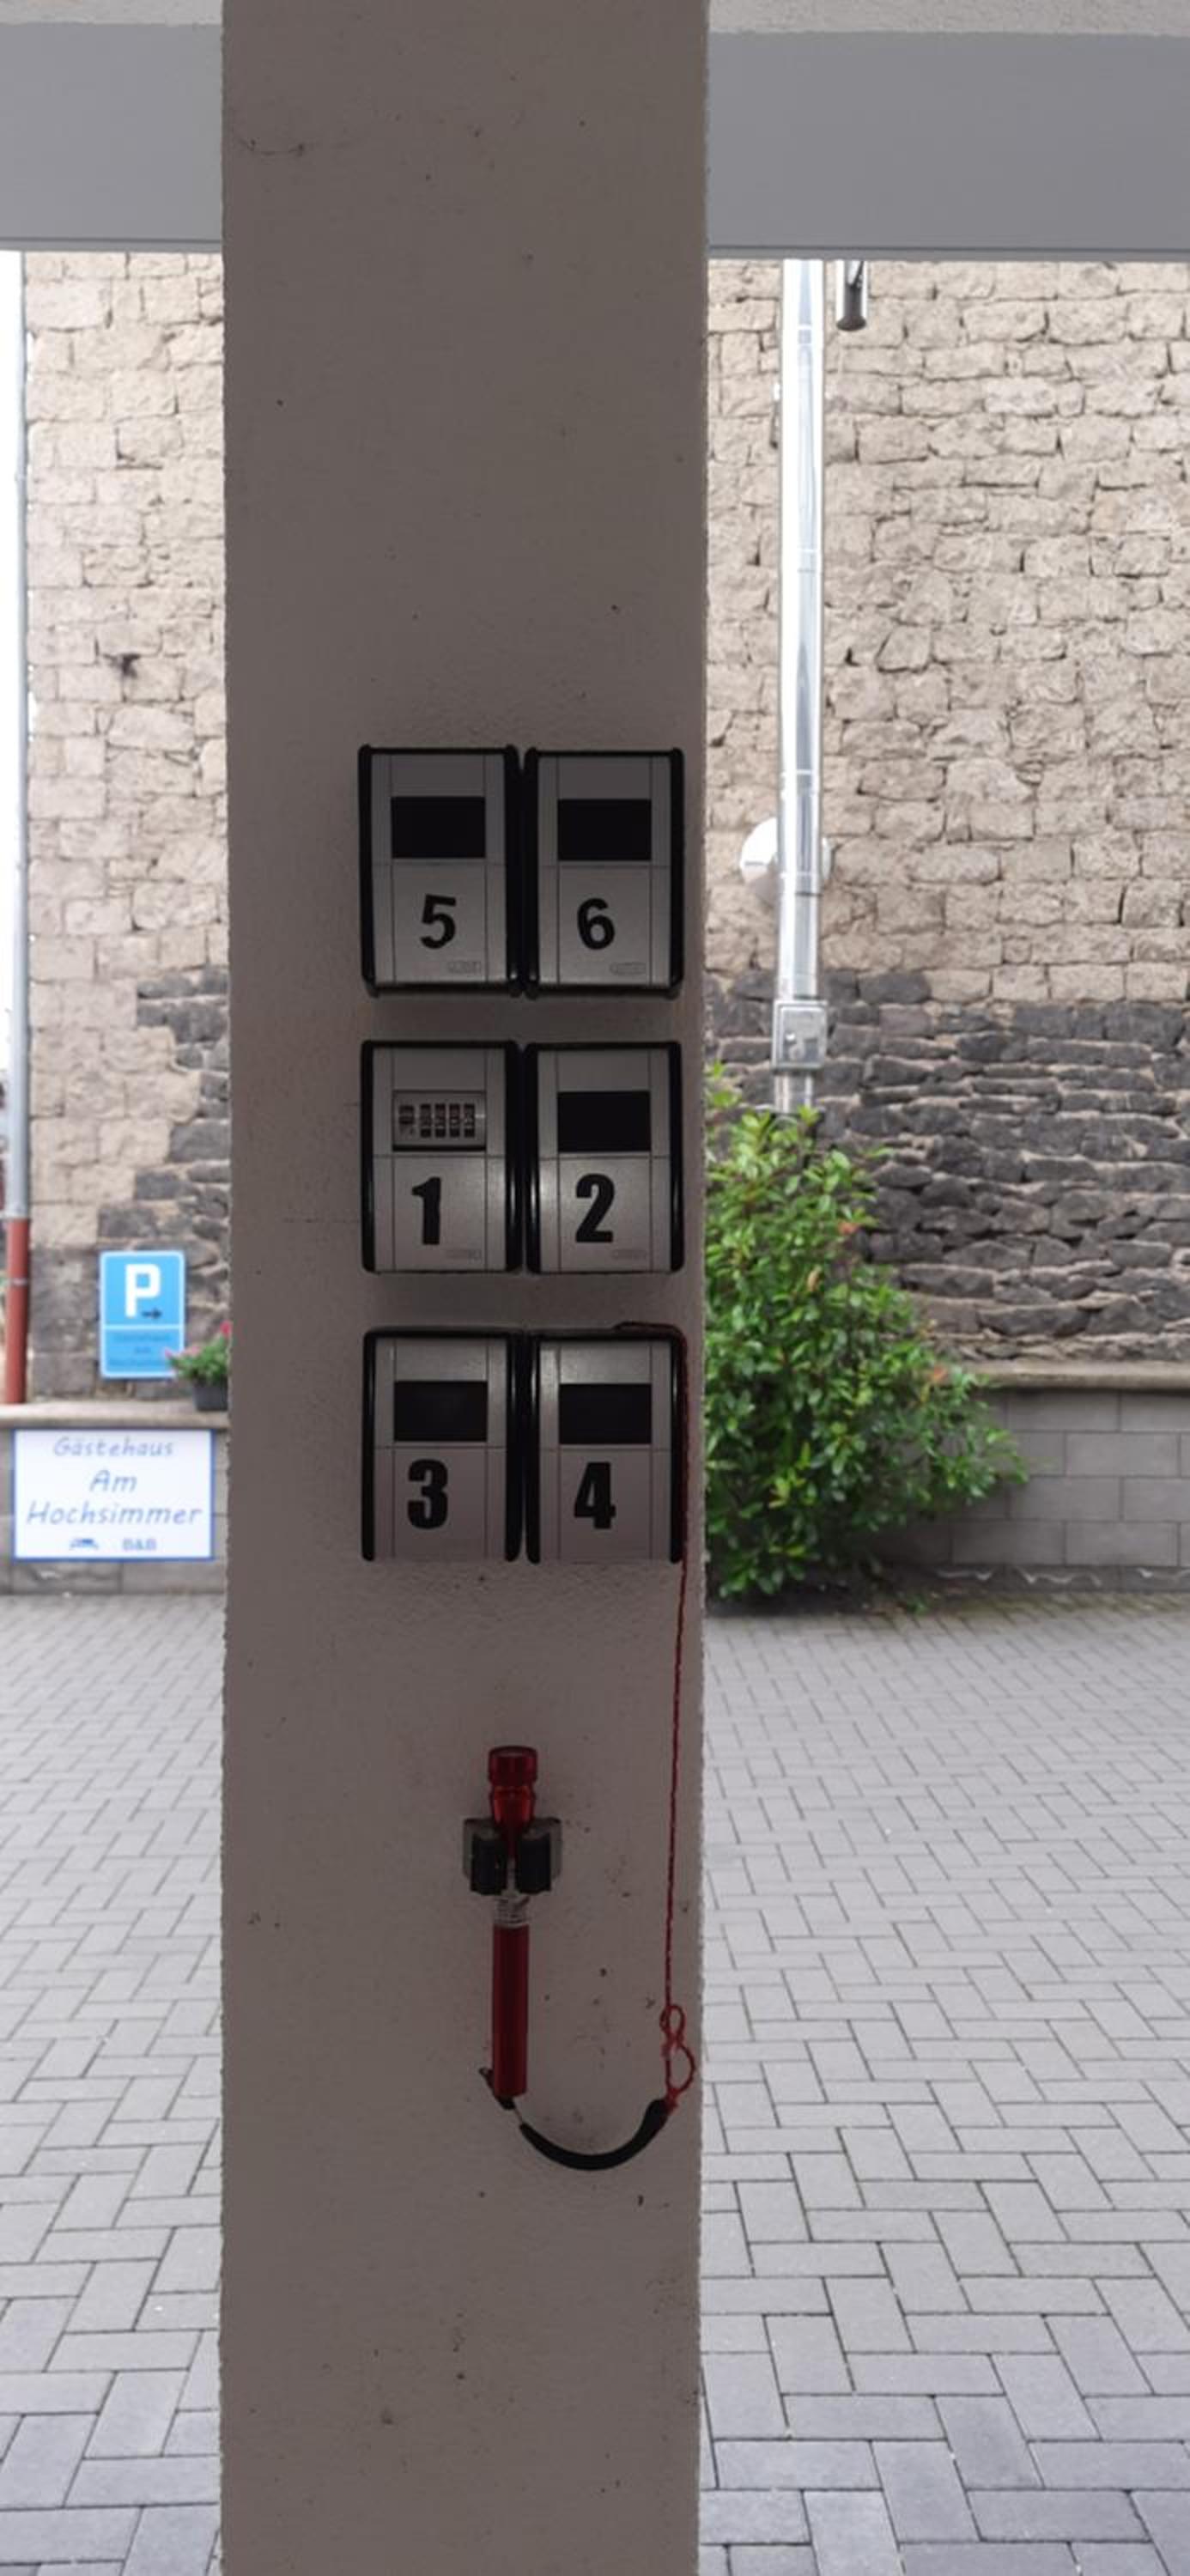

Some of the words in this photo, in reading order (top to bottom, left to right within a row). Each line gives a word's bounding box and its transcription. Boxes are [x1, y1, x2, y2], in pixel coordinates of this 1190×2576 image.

[420, 893, 457, 950] 5
[576, 897, 616, 951] 6
[411, 1176, 442, 1246] 1
[575, 1174, 616, 1243] 2
[124, 1263, 161, 1318] P
[52, 1436, 174, 1457] Gästehaus
[89, 1469, 138, 1492] Am
[407, 1459, 449, 1530] 3
[573, 1461, 617, 1530] 4
[26, 1500, 203, 1525] Hochsimmer
